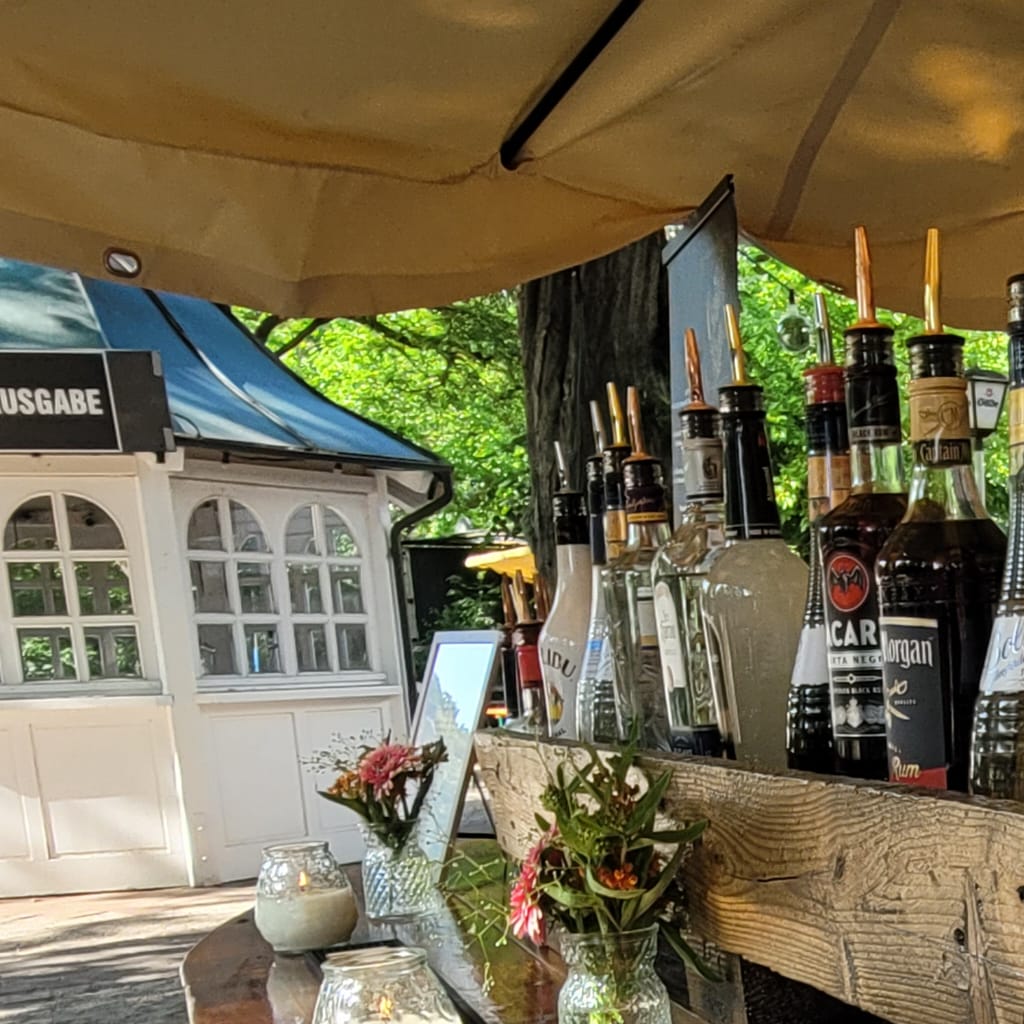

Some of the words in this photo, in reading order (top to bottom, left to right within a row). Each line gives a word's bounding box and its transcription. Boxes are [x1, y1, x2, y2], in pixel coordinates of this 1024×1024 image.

[0, 387, 104, 415] USGABE
[827, 618, 878, 647] CAR
[541, 648, 577, 679] LIBU
[891, 756, 921, 781] Rum
